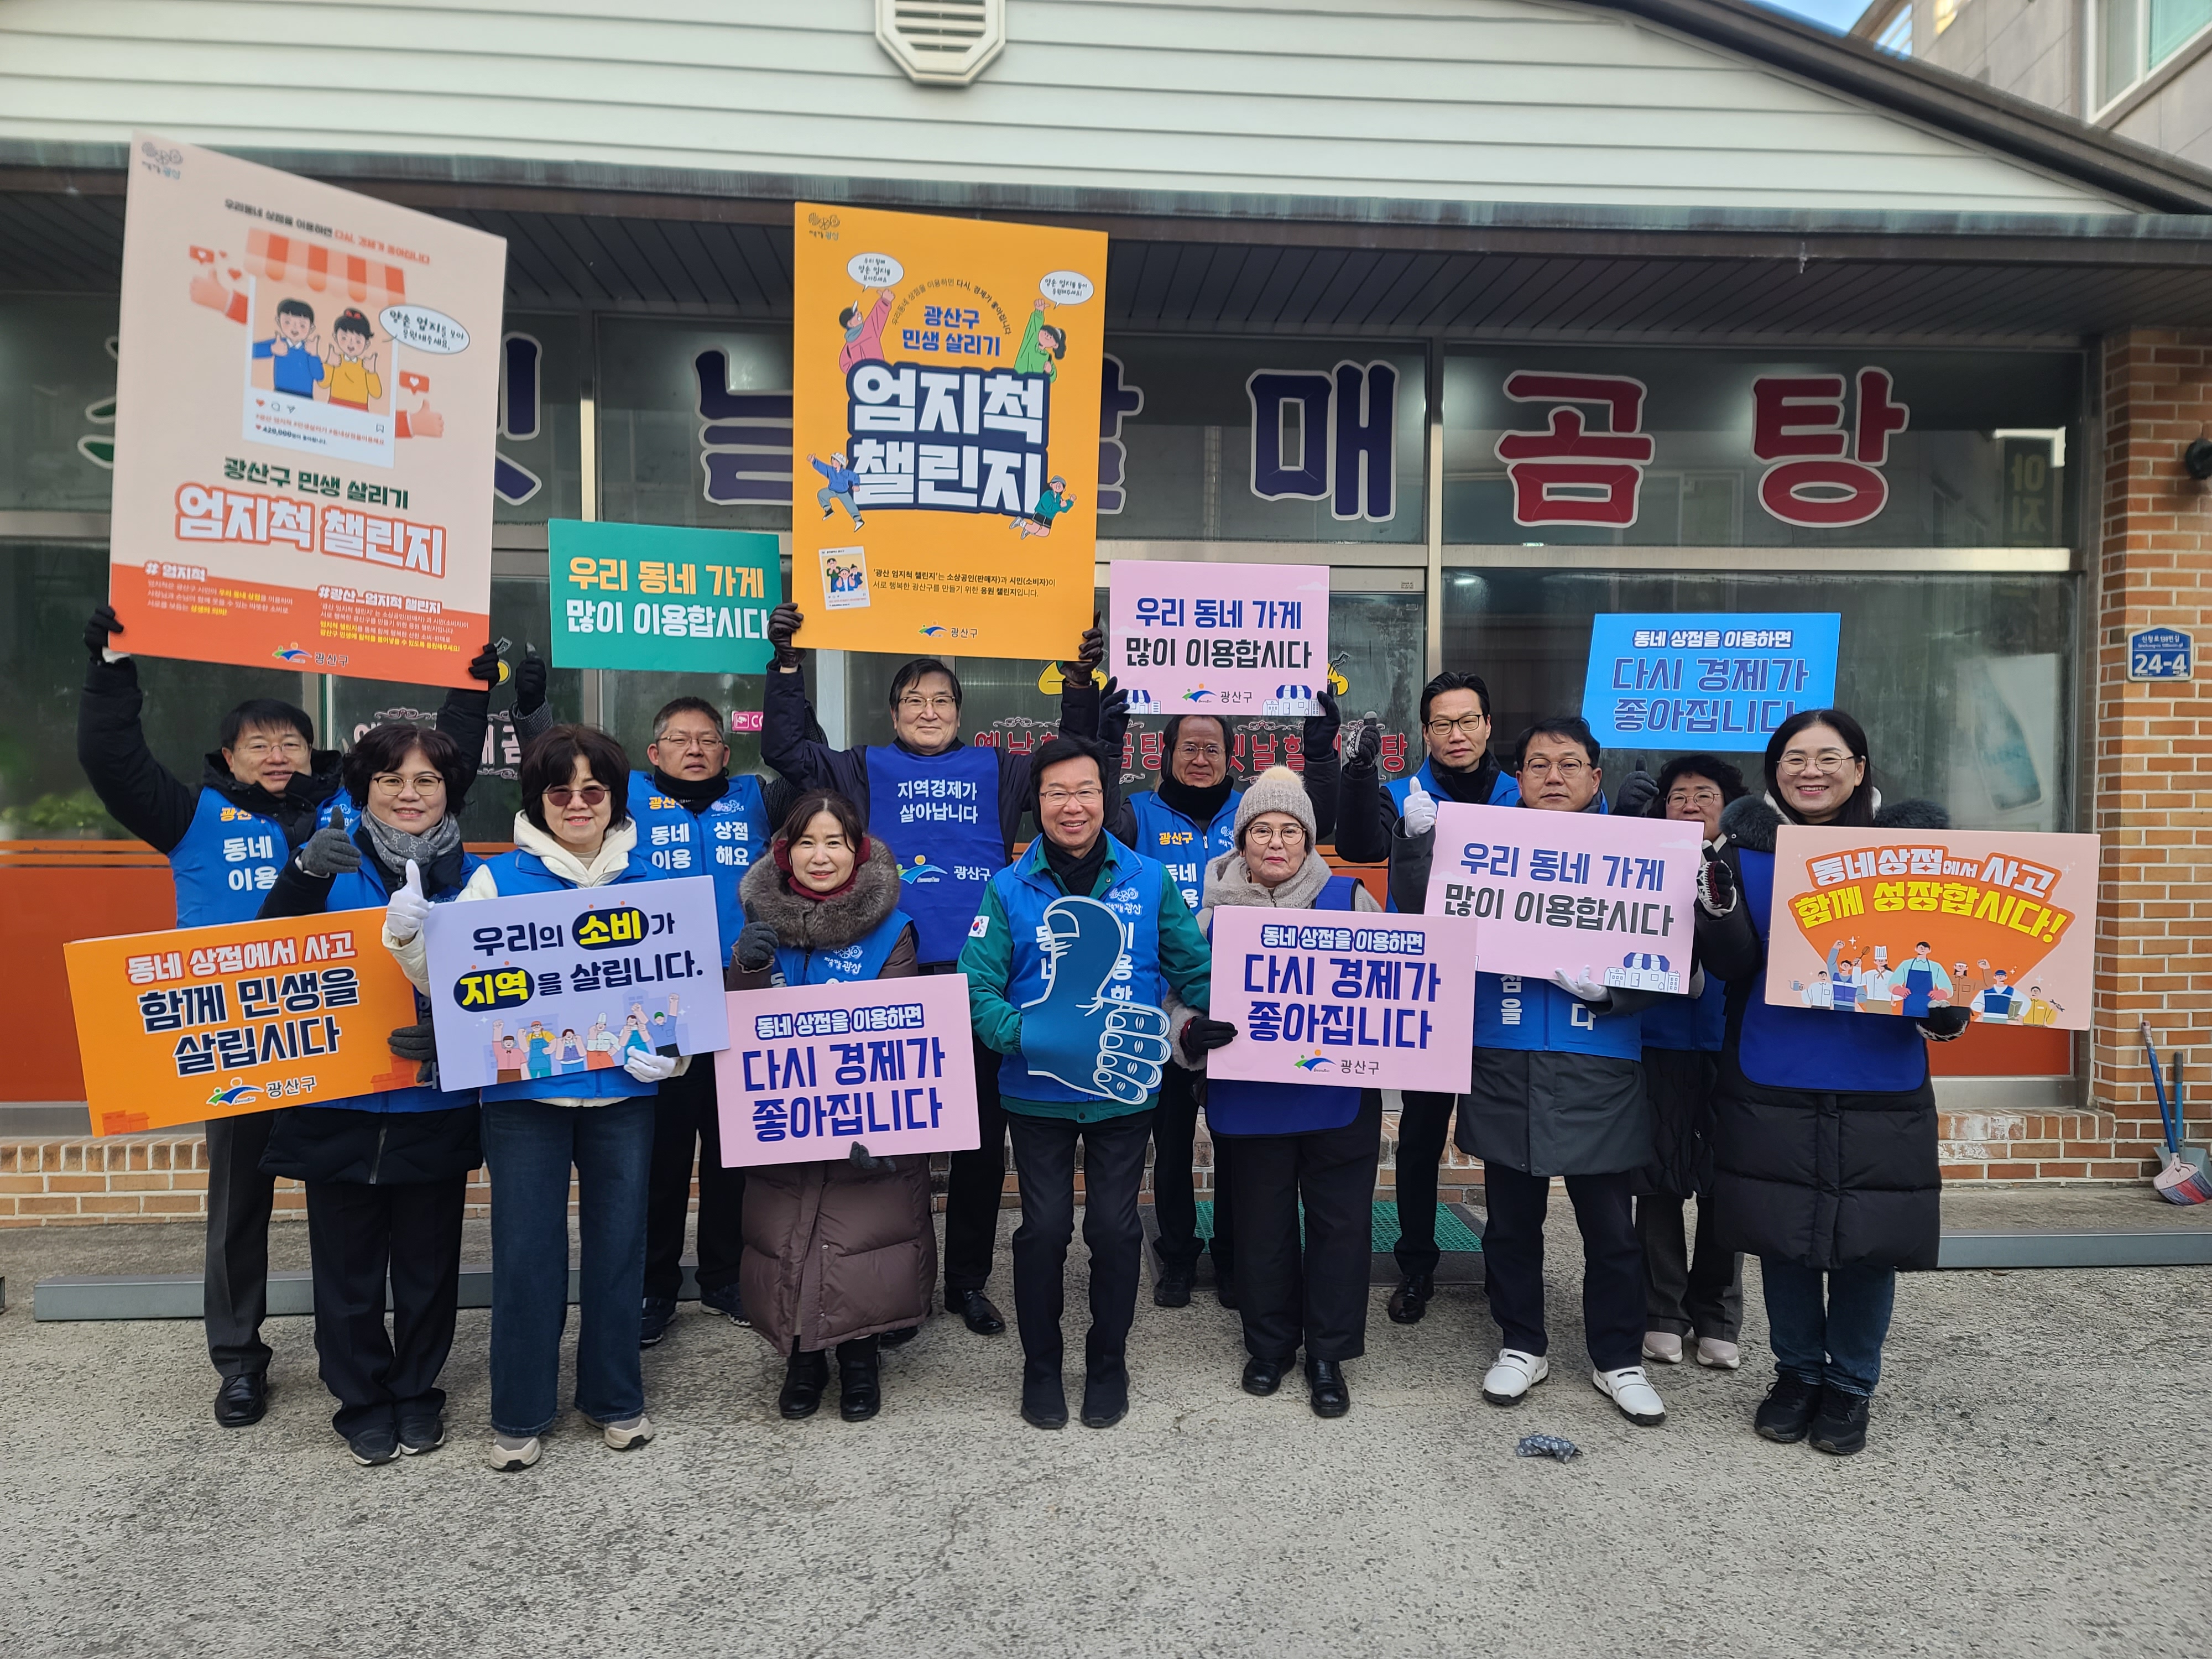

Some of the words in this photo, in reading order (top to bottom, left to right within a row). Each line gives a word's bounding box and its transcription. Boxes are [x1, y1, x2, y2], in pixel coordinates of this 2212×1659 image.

[924, 305, 980, 330] 광산구
[973, 285, 992, 303] 경제가
[991, 301, 1011, 335] 좋아집니다
[902, 328, 940, 352] 민생
[945, 332, 1000, 357] 살리기
[853, 365, 1044, 444] 엄지척
[224, 455, 291, 489] 광산구
[298, 469, 341, 497] 민생
[347, 479, 409, 510] 살리기
[853, 437, 1041, 514] 챌린지
[177, 484, 314, 551] 엄지척
[322, 508, 444, 577] 챌린지
[162, 562, 206, 582] 엄지척
[568, 557, 628, 591] 우리
[638, 560, 697, 595] 동네
[705, 565, 765, 598] 가게
[891, 570, 912, 580] 엄지척
[947, 573, 1008, 585] 소상공인(판매자)과
[1010, 576, 1056, 587] 시민(소비자)이
[873, 581, 887, 589] 서로
[889, 581, 910, 591] 행복한
[912, 583, 940, 593] 광산구를
[942, 585, 963, 594] 만들기
[965, 586, 978, 595] 위한
[980, 587, 994, 596] 응원
[996, 587, 1039, 598] 챌린지입니다.
[405, 597, 441, 614] 챌린지
[566, 599, 624, 634] 많이
[633, 603, 770, 640] 이용합시다
[1136, 598, 1185, 627] 우리
[1194, 599, 1243, 628] 동네
[1252, 600, 1302, 629] 가게
[951, 627, 978, 639] 광산구
[1633, 630, 1667, 647] 동네
[1670, 631, 1720, 648] 상점을
[1724, 630, 1792, 648] 이용하면
[314, 652, 348, 667] 광산구
[1126, 638, 1176, 667] 많이
[1186, 638, 1312, 669] 이용합시다
[2135, 654, 2187, 674] 24-4
[1612, 658, 1684, 691] 다시
[1697, 658, 1809, 692] 경제가
[1220, 691, 1253, 703] 광산구
[649, 796, 685, 810] 광산
[898, 779, 978, 801] 지역경제가
[221, 807, 252, 822] 광산
[899, 802, 978, 824] 살아납니다
[650, 823, 690, 846] 동네
[713, 821, 749, 841] 상점
[1159, 831, 1193, 845] 광산구
[223, 836, 273, 862] 동네
[651, 848, 691, 870] 이용
[715, 846, 749, 866] 해요
[228, 865, 278, 891] 이용
[953, 865, 991, 881] 광산구
[1460, 842, 1520, 878] 우리
[1529, 848, 1591, 884] 동네
[1602, 854, 1665, 891] 가게
[1812, 848, 1979, 886] 동네상점에서
[1980, 856, 2056, 899] 사고
[1124, 903, 1142, 915] 광산
[1444, 883, 1505, 920] 많이
[1514, 891, 1674, 937] 이용합시다
[1794, 885, 1865, 929] 함께
[1872, 880, 2067, 943] 성장합시다!
[473, 922, 564, 957] 우리의
[578, 910, 676, 946] 소비가
[1262, 926, 1296, 948] 동네
[1301, 928, 1352, 950] 상점을
[1355, 931, 1424, 954] 이용하면
[128, 952, 182, 983] 동네
[190, 938, 296, 976] 상점에서
[304, 932, 357, 962] 사고
[842, 960, 862, 975] 광산
[460, 969, 563, 1006] 지역을
[570, 950, 703, 993] 살립니다.
[1244, 954, 1316, 996] 다시
[1329, 958, 1442, 1003] 경제가
[138, 982, 228, 1034] 함께
[236, 967, 360, 1020] 민생을
[757, 1016, 792, 1039] 동네
[796, 1010, 849, 1036] 상점을
[853, 1005, 922, 1031] 이용하면
[1248, 1001, 1433, 1050] 좋아집니다
[173, 1015, 342, 1077] 살립시다
[742, 1046, 817, 1092] 다시
[829, 1037, 946, 1086] 경제가
[1340, 1059, 1380, 1076] 광산구
[267, 1076, 317, 1099] 광산구
[752, 1087, 943, 1142] 좋아집니다
